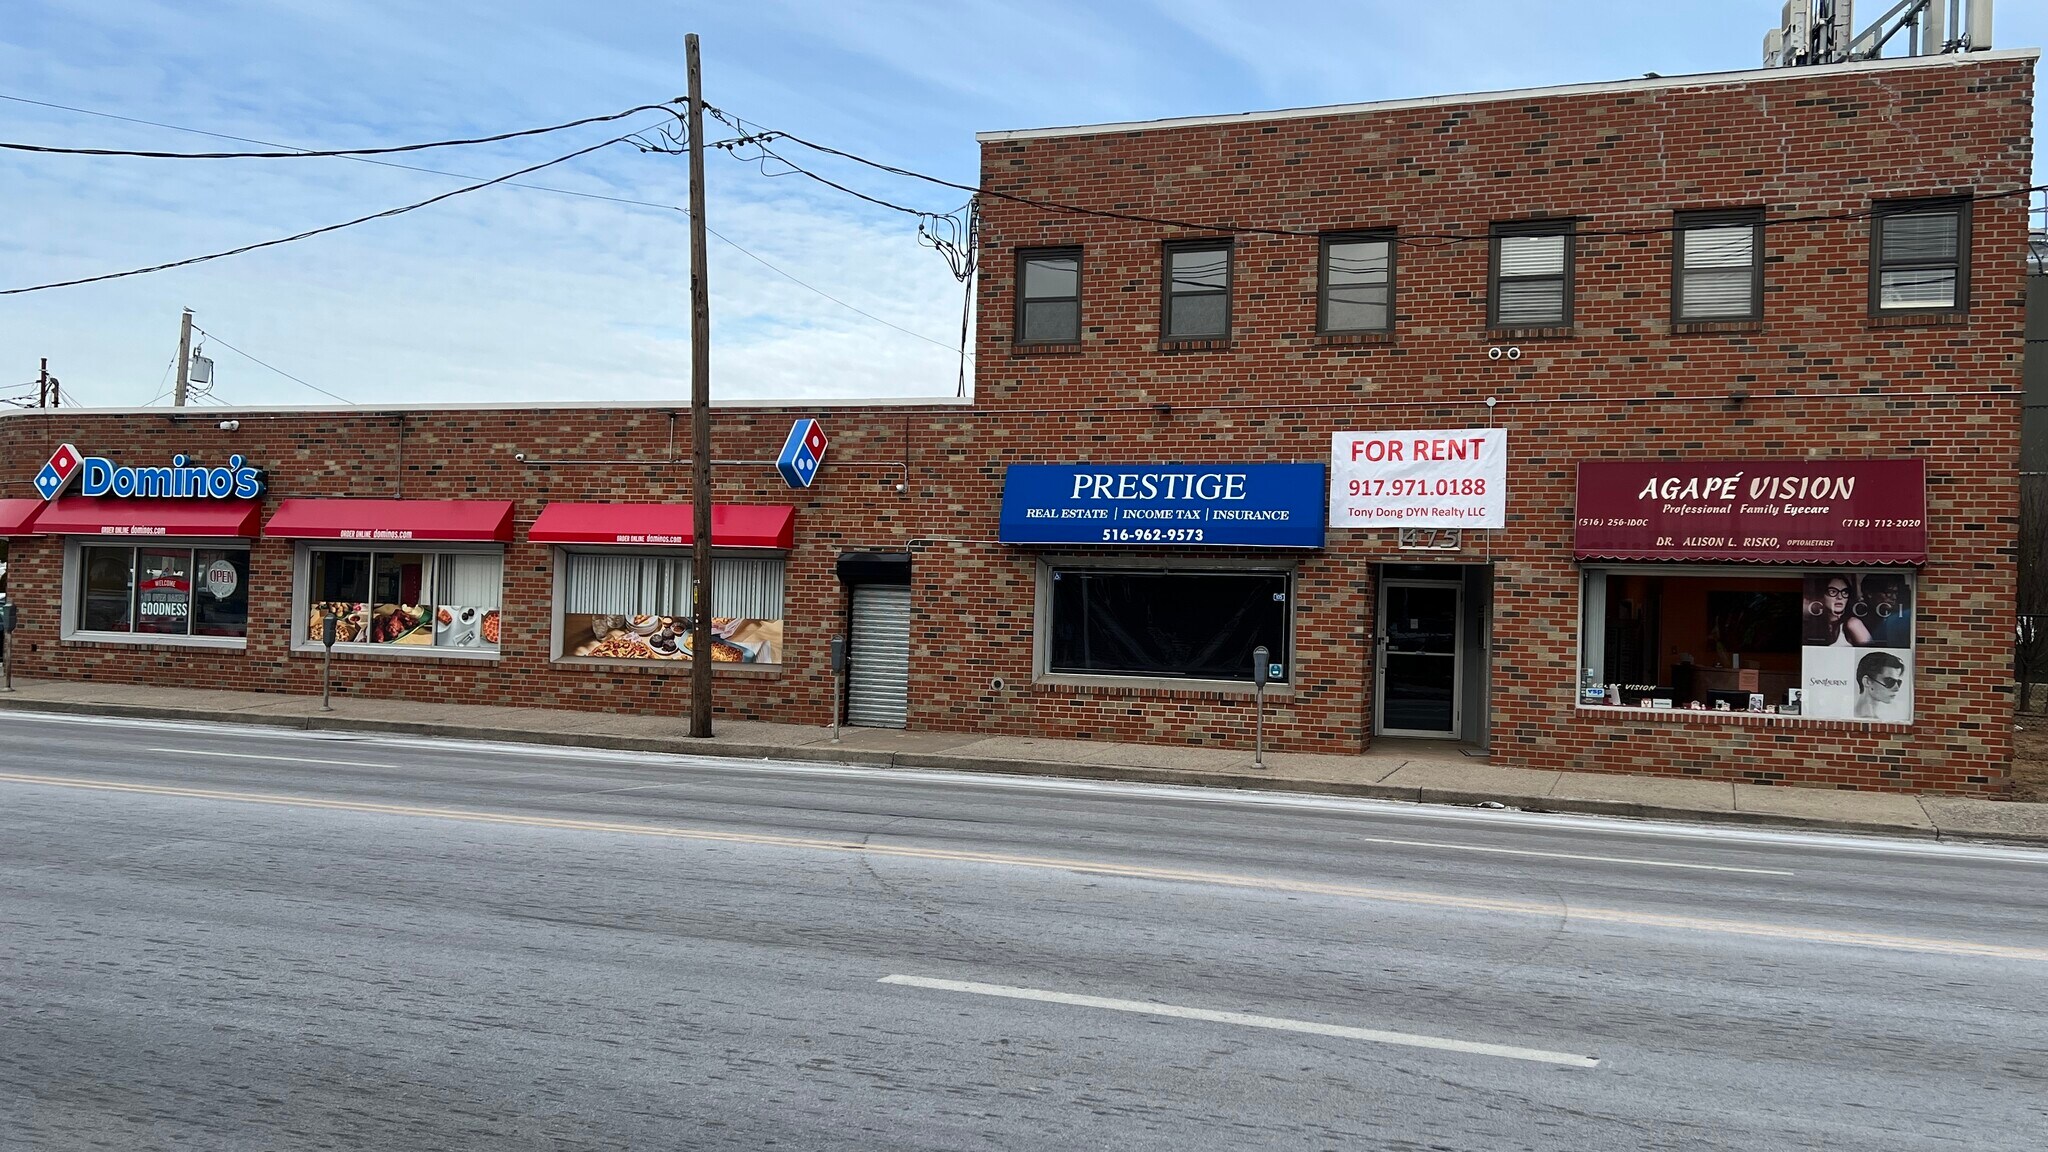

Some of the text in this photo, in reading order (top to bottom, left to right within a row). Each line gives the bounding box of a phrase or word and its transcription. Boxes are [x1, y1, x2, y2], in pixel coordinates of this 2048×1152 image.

[1351, 438, 1486, 462] FOR RENT
[81, 454, 262, 499] Domino's
[1070, 474, 1247, 500] PRESTIGE
[1349, 478, 1486, 497] 917.971.0188
[1638, 471, 1856, 500] AGAPÉ VISION
[1025, 508, 1109, 519] REAL ESTATE
[1122, 509, 1201, 520] INCOME TAX
[1213, 510, 1290, 521] INSURANCE
[1348, 506, 1486, 519] Tony Dong DYN Realty LLC
[1662, 503, 1829, 516] Professional Family Eyecare
[1578, 518, 1604, 527] (516)
[1842, 518, 1921, 529] (718) 712-2020
[131, 525, 166, 535] dominos.com
[356, 530, 371, 538] ONLINE
[373, 529, 413, 539] dominos.com
[1102, 528, 1204, 542] 516-962-9573
[646, 533, 682, 543] dominos.com
[1403, 528, 1460, 548] 475
[1656, 536, 1835, 550] DR. ALISON L. RISKO, OPTOMETRIST
[209, 568, 234, 584] OPEN
[154, 579, 177, 588] WELCOME
[141, 602, 188, 616] GOODNESS
[1625, 683, 1657, 691] VISION
